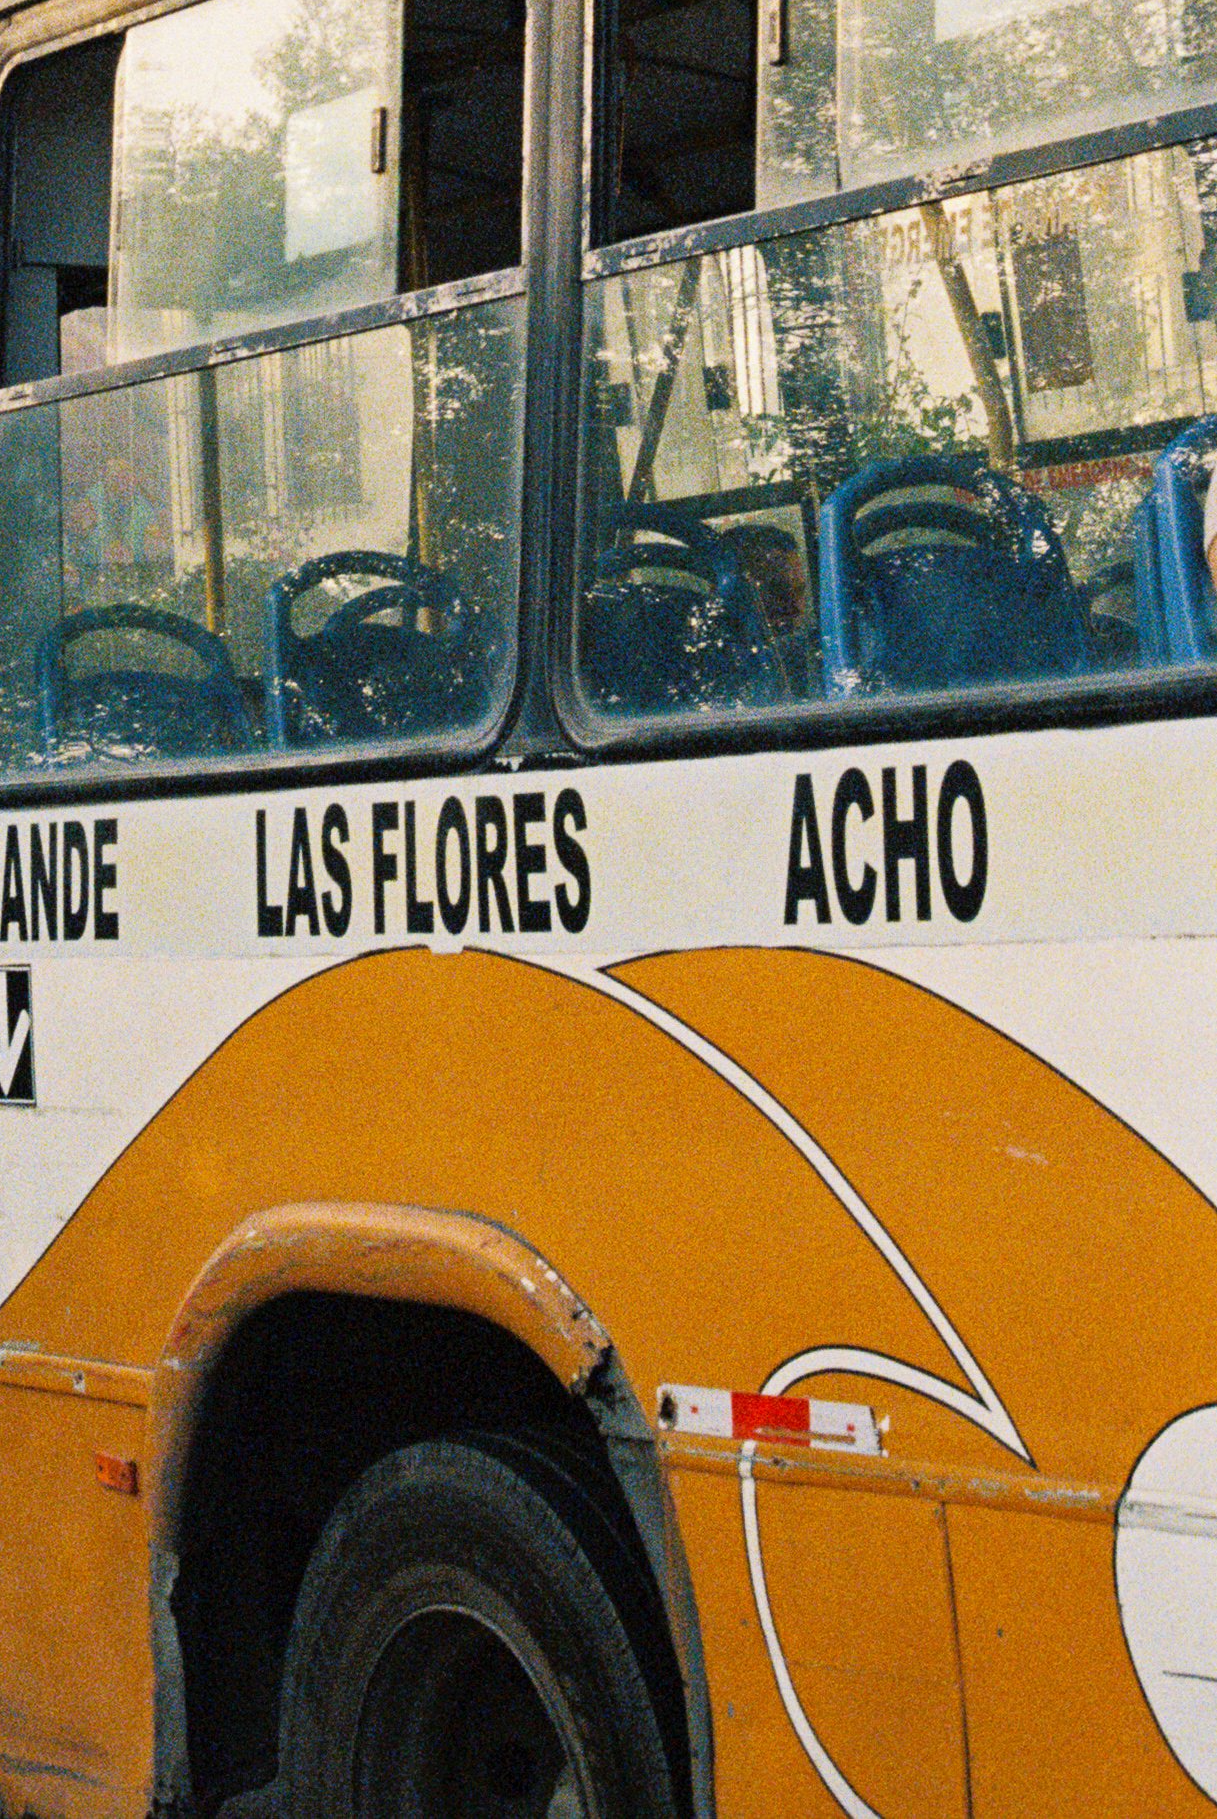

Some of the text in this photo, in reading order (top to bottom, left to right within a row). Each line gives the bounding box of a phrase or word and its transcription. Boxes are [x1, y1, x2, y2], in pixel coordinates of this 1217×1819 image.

[257, 787, 592, 938] LAS FLORES
[784, 759, 989, 926] ACHO
